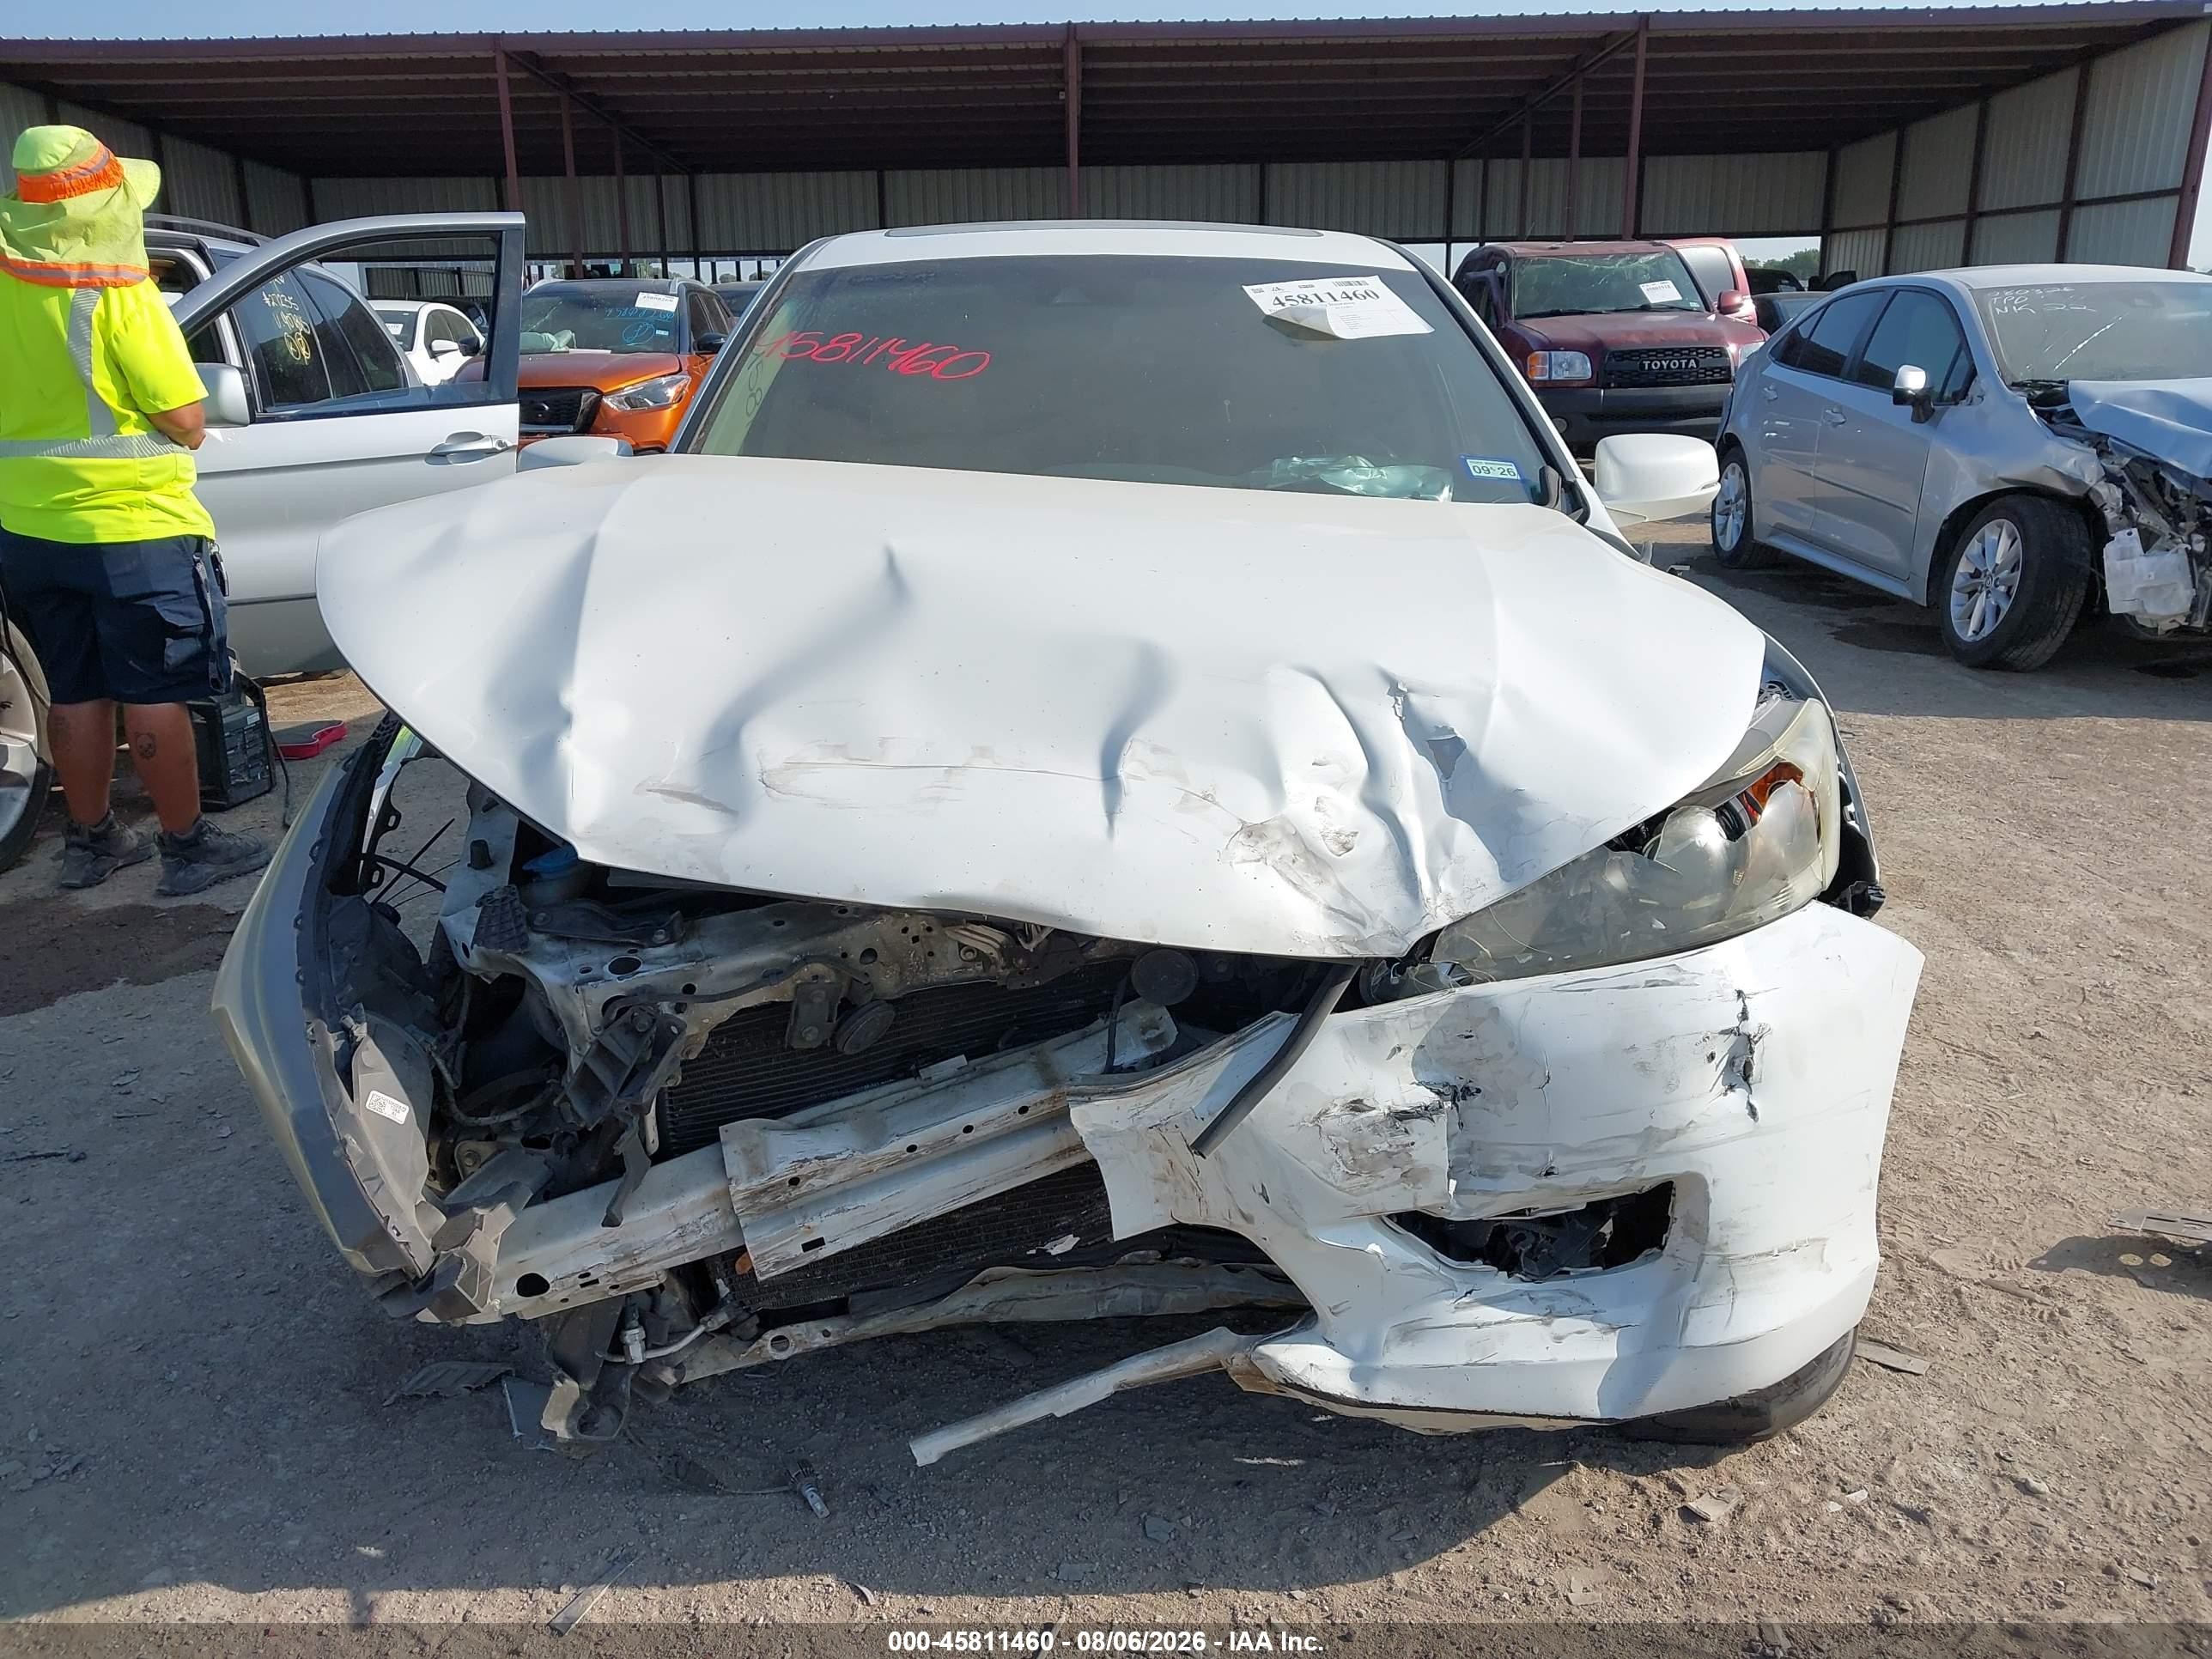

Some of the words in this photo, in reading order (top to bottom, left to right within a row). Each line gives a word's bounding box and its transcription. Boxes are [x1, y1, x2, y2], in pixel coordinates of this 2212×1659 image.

[1272, 289, 1380, 308] 45811460
[1642, 358, 1697, 371] TOYOTA
[1472, 465, 1491, 475] 09
[1497, 466, 1516, 477] 26
